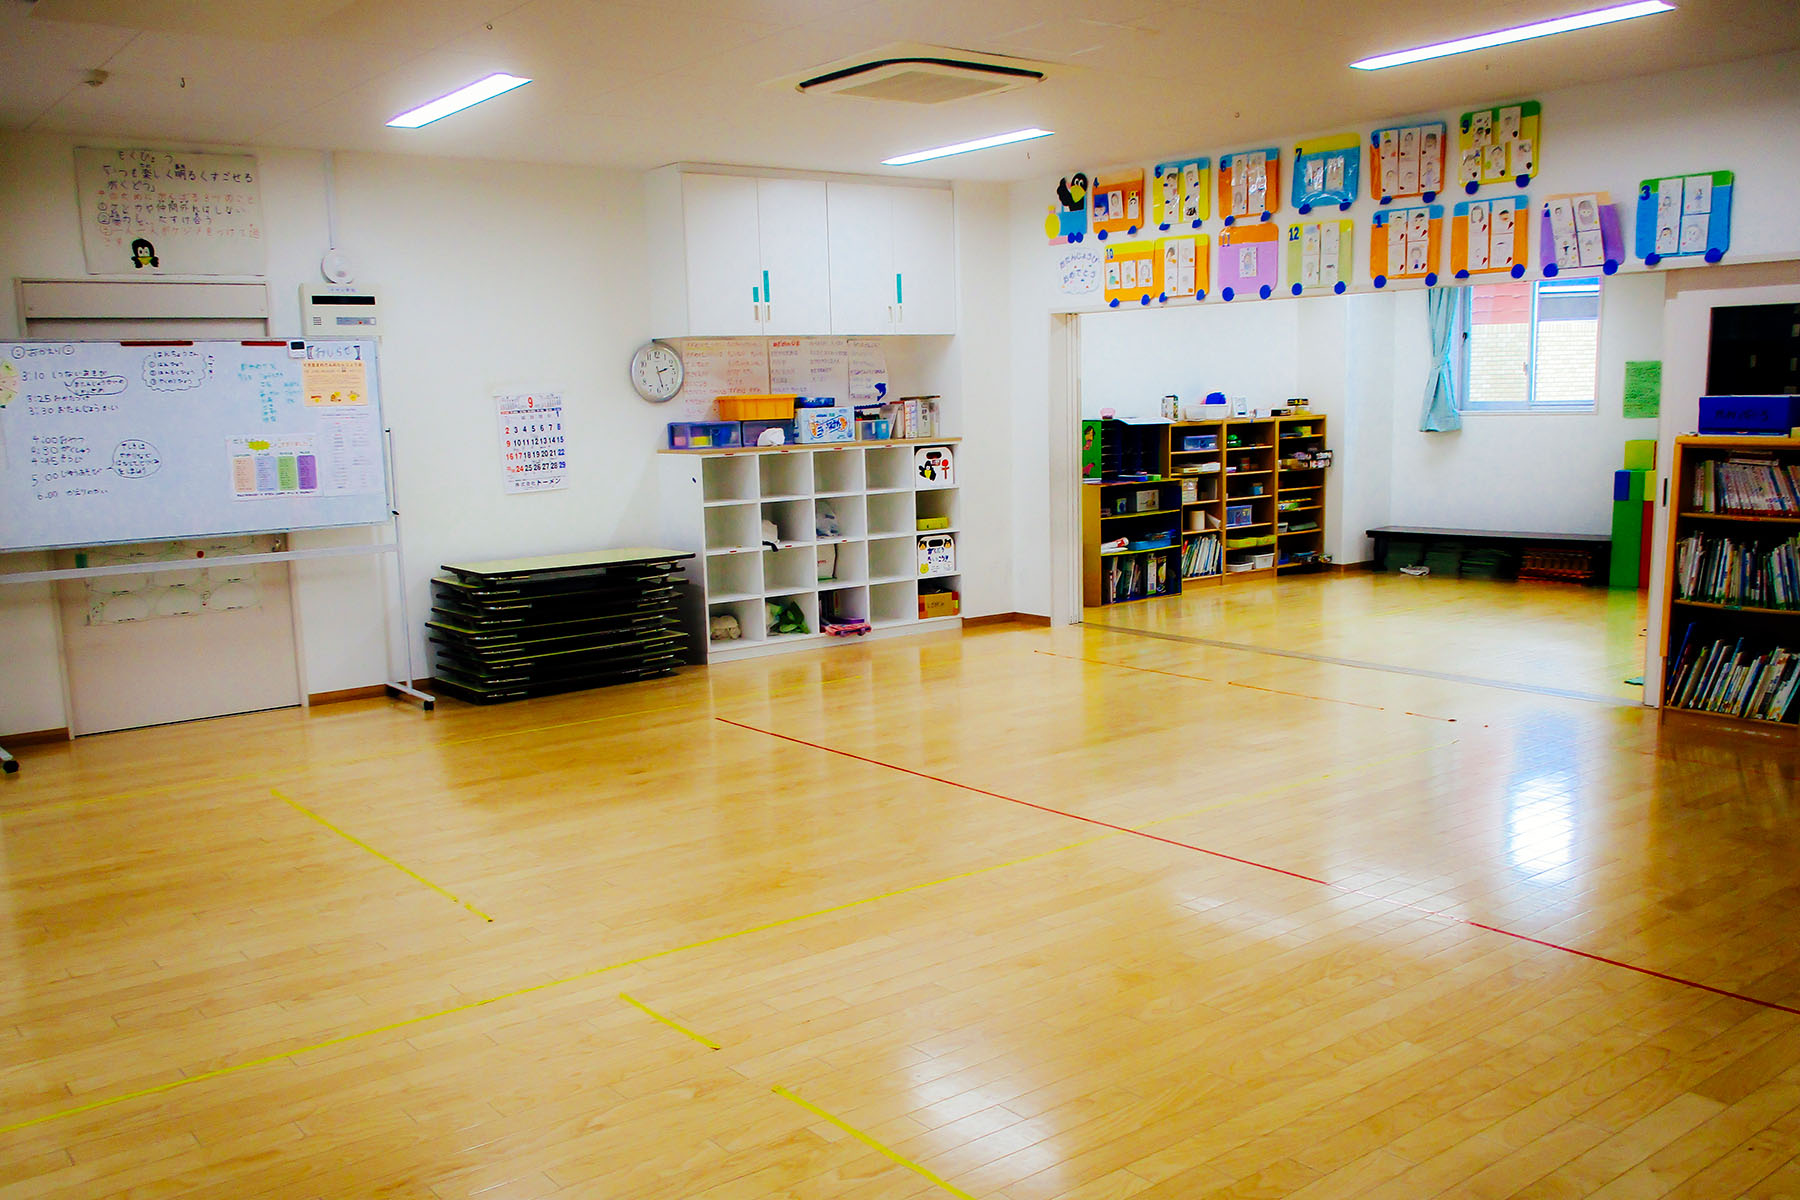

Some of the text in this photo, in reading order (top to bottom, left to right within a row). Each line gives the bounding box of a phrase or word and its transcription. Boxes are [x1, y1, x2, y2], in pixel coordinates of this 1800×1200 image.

[1296, 148, 1303, 163] 7
[1155, 166, 1161, 179] 5
[1640, 185, 1651, 201] 3
[1375, 214, 1383, 228] 1
[1222, 232, 1230, 247] 11
[1289, 226, 1299, 241] 12
[528, 397, 533, 408] 9
